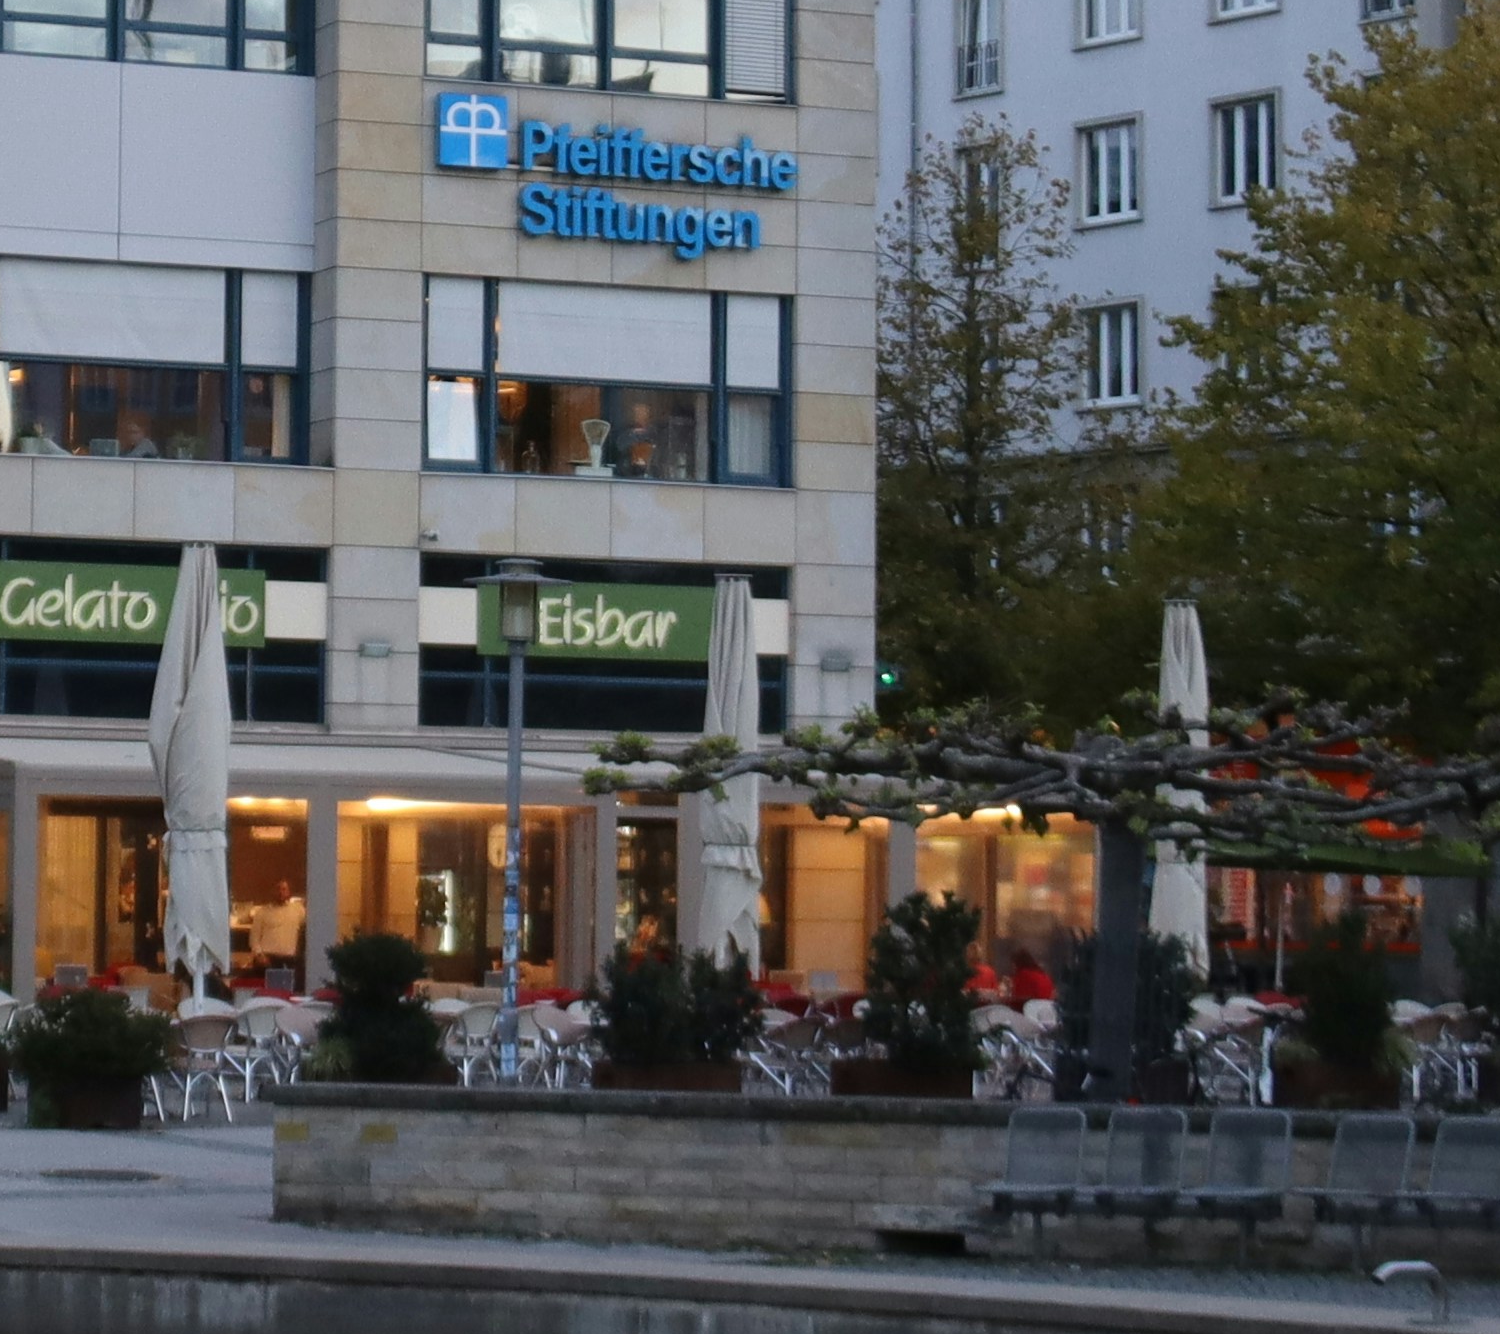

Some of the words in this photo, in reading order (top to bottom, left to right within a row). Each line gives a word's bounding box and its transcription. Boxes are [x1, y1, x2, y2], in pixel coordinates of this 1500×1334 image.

[519, 119, 799, 191] Pfeiffersche
[519, 182, 762, 260] Stiftungen
[0, 573, 157, 631] Gelato
[538, 592, 677, 649] Eisbar
